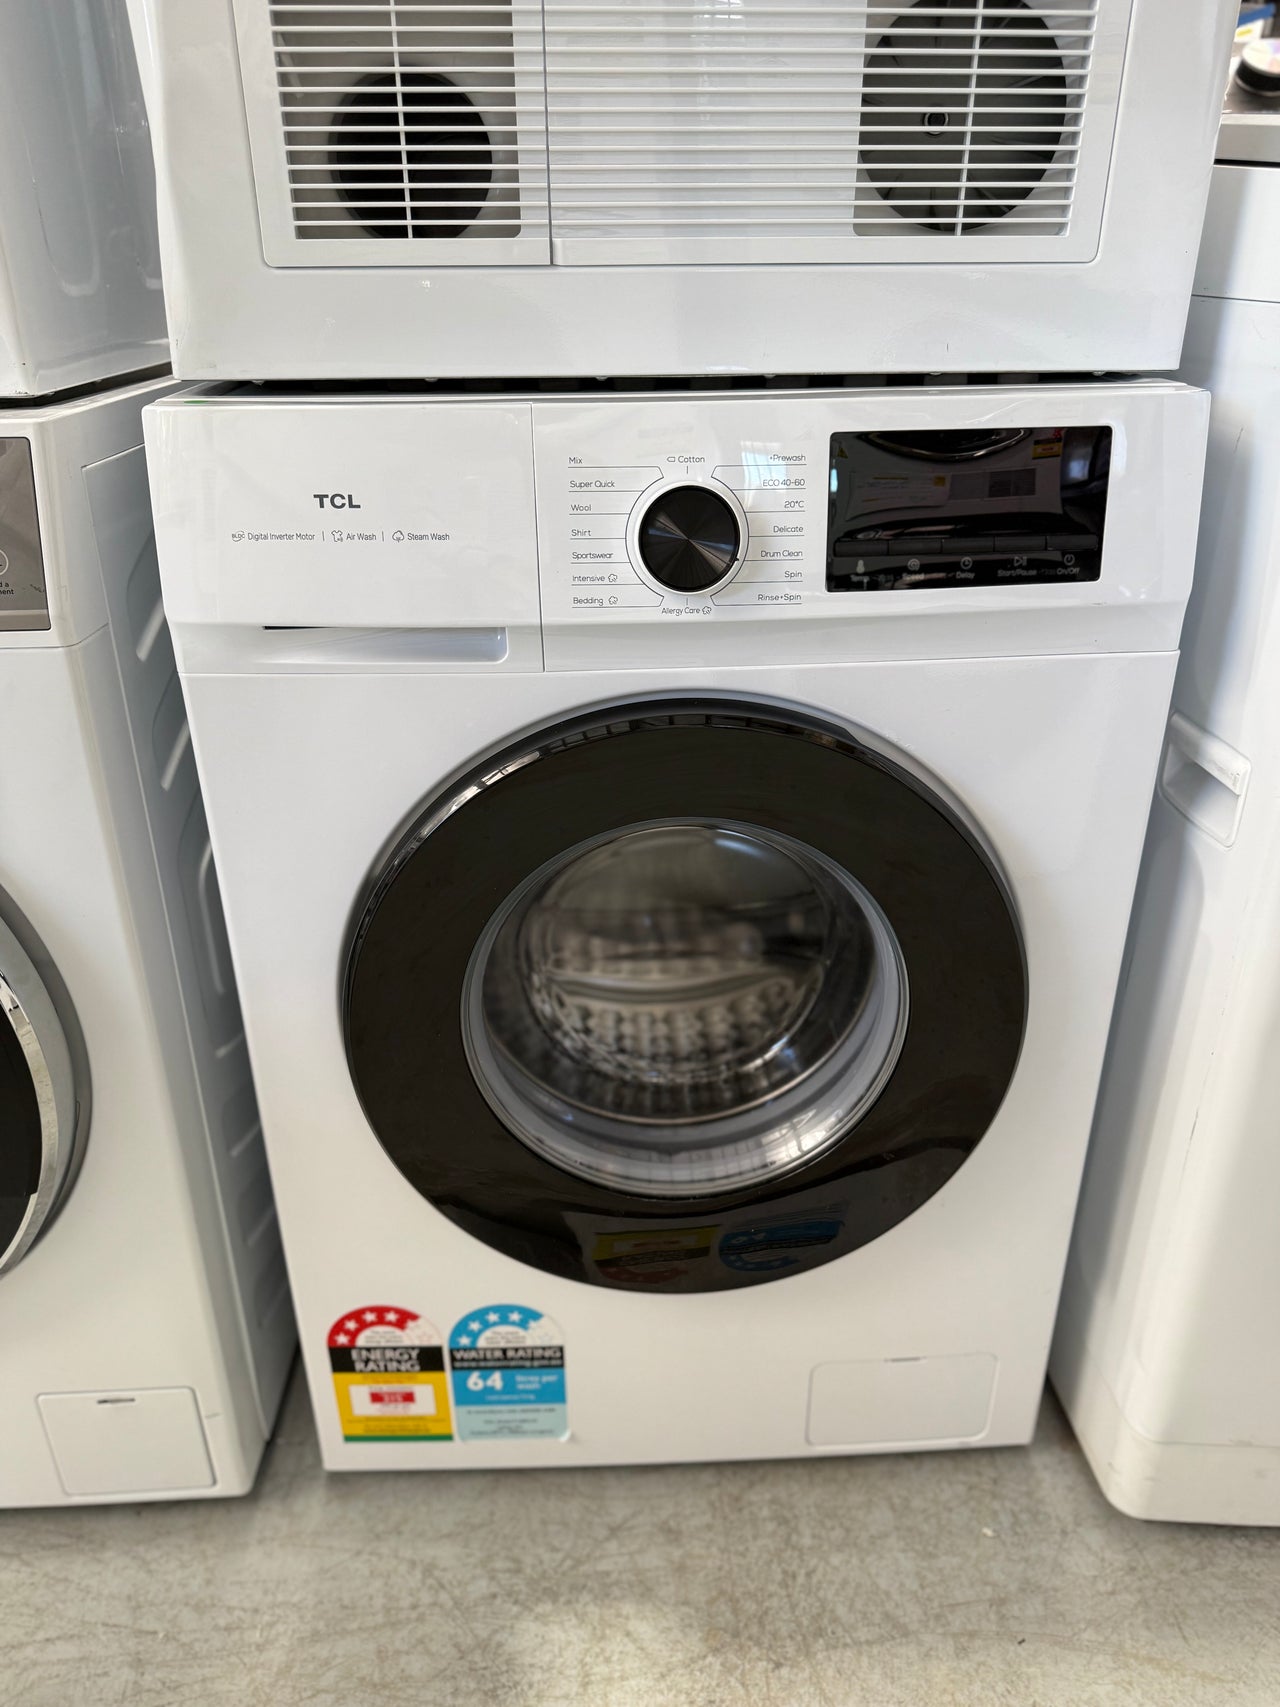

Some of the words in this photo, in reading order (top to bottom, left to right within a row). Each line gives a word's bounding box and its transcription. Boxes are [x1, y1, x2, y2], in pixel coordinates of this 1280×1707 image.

[569, 456, 583, 464] Mix
[570, 480, 592, 489] Super
[594, 480, 615, 488] Quick
[763, 479, 780, 487] ECO
[780, 478, 805, 486] 40-60
[313, 494, 361, 509] TCL
[784, 500, 804, 508] 20°C
[571, 504, 592, 512] Wool
[773, 525, 804, 533] Delicate
[247, 532, 269, 541] Digital
[270, 533, 295, 541] Inverter
[296, 533, 315, 541] Motor
[356, 533, 376, 541] Wash
[407, 533, 429, 541] Steam
[430, 533, 450, 541] Wash
[572, 552, 613, 560] Sportswear
[785, 571, 802, 579] Spin
[1056, 567, 1081, 576] On/Off
[573, 574, 605, 582] Intensive
[573, 597, 604, 606] Bedding
[662, 607, 683, 615] Allergy
[351, 1348, 420, 1360] ENERGY
[453, 1350, 503, 1360] WATER
[506, 1348, 562, 1358] RATING
[354, 1360, 421, 1372] RATING
[467, 1371, 503, 1391] 64
